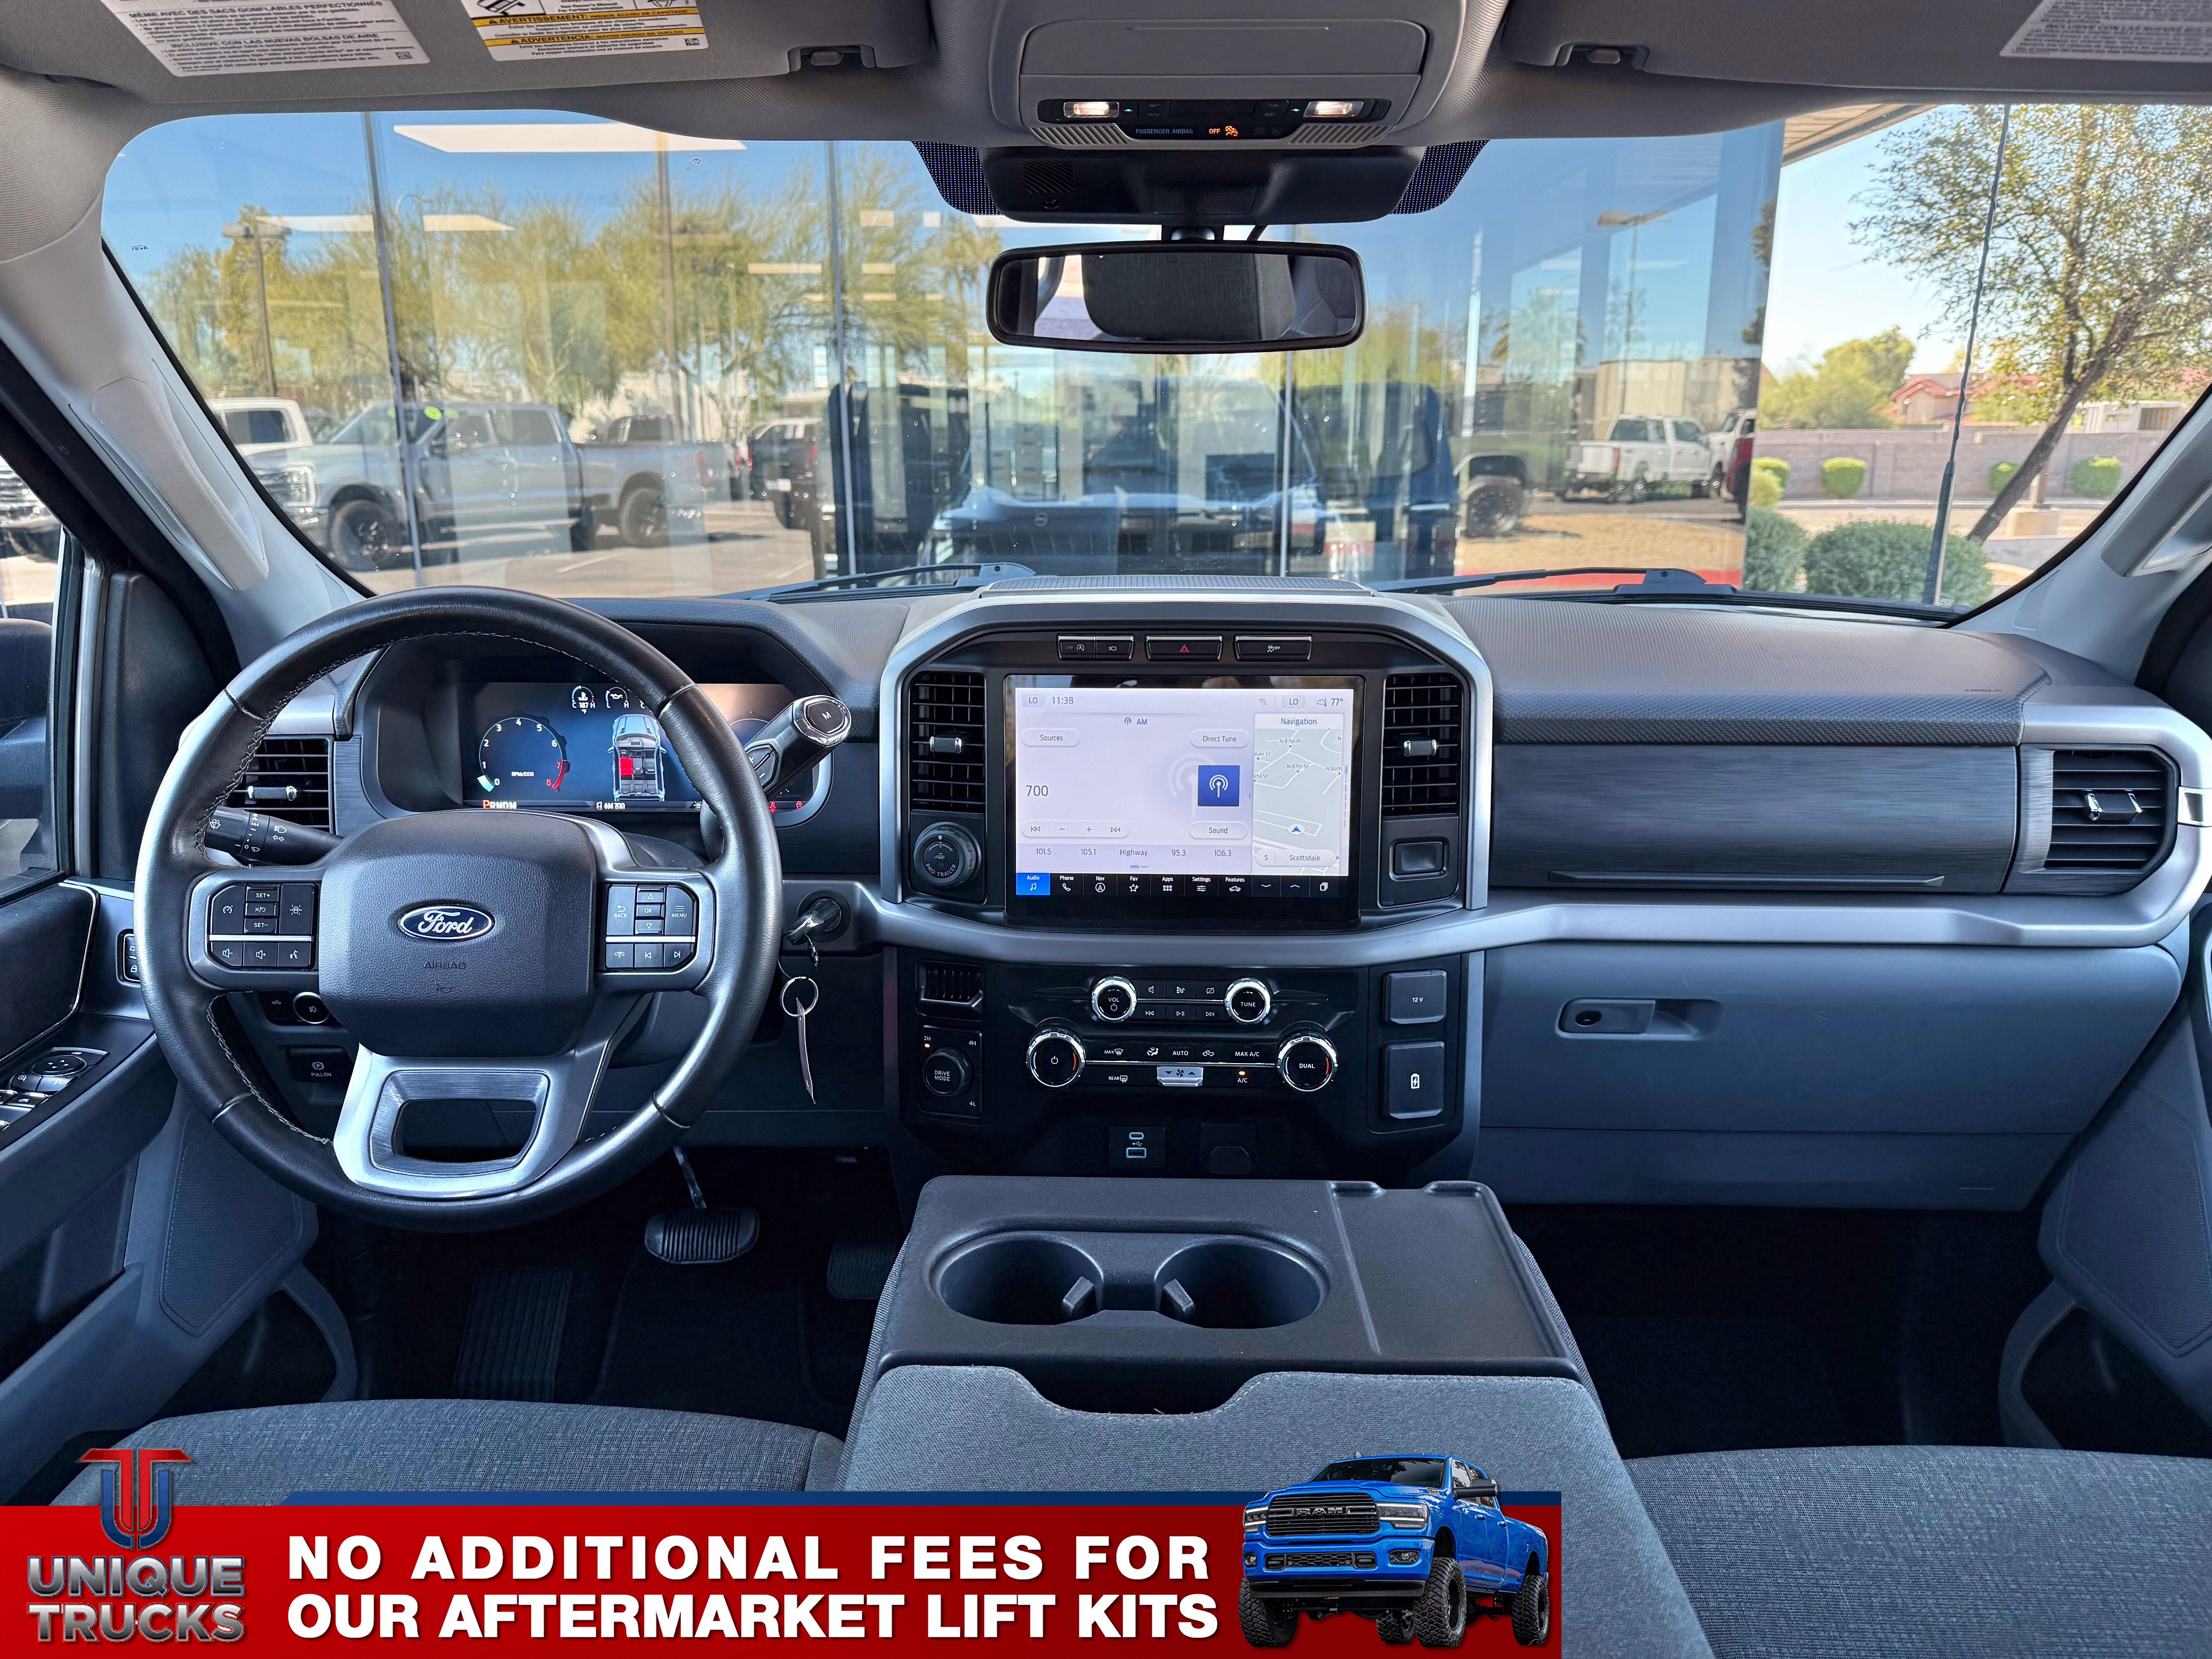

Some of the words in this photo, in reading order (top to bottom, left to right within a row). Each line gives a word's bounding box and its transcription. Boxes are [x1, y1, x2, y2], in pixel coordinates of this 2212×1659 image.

[822, 711, 832, 720] M
[1281, 718, 1317, 726] Navigation
[552, 739, 557, 747] 6
[1026, 785, 1048, 796] 700
[925, 863, 935, 874] PRO
[937, 864, 957, 877] TRAILER
[418, 910, 474, 934] Ford
